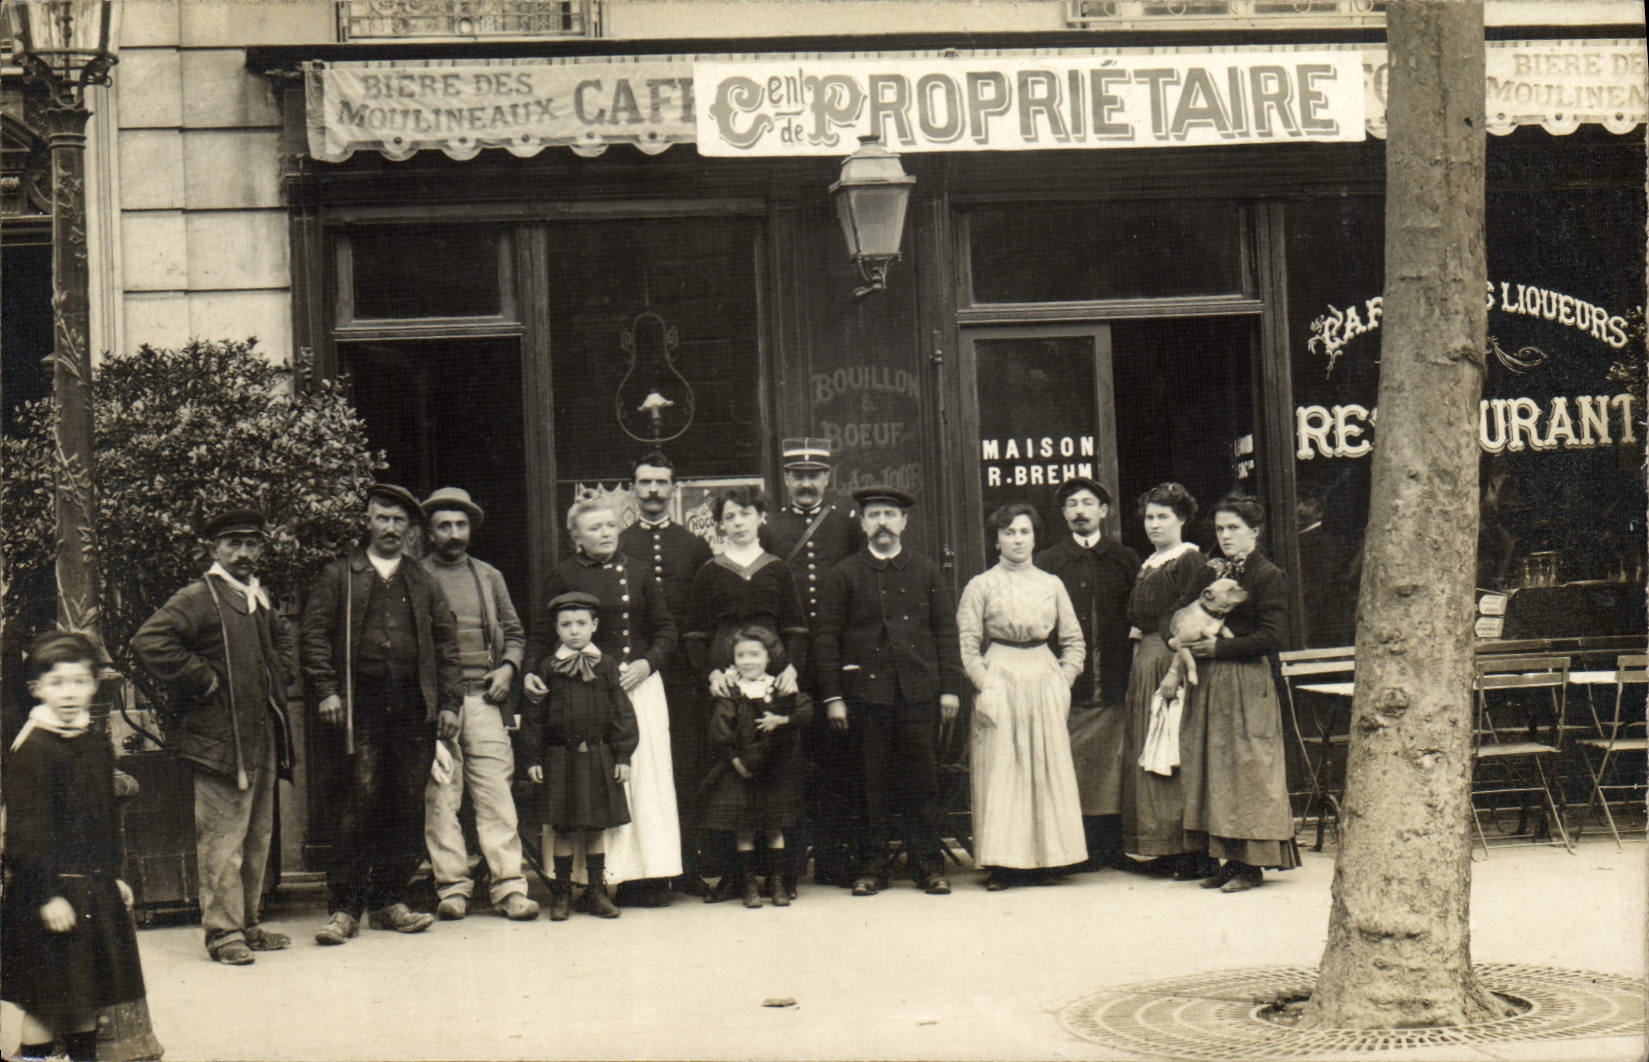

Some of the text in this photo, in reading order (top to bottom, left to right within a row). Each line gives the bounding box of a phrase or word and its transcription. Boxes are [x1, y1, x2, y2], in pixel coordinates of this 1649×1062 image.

[473, 72, 533, 96] DES
[337, 98, 559, 133] MOULINEAUX
[804, 59, 1338, 148] PROPRIÉTAIRE
[781, 117, 804, 143] de
[1500, 281, 1629, 348] LIQUEURS
[810, 366, 920, 404] BOUILLON
[861, 393, 880, 412] &
[820, 420, 905, 453] BOEUF
[982, 436, 1095, 460] MAISON
